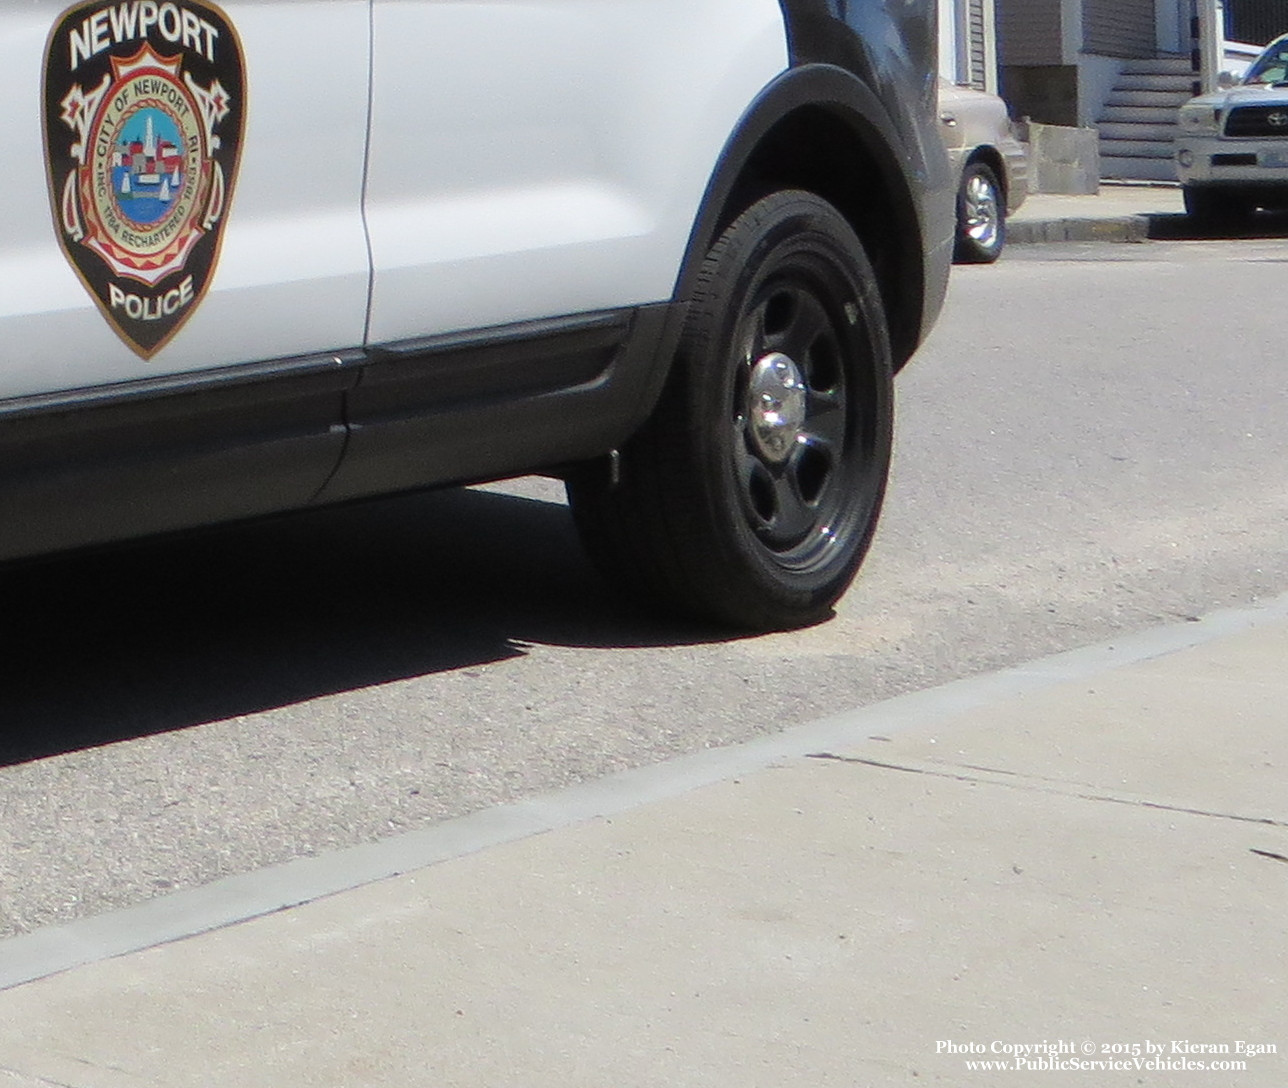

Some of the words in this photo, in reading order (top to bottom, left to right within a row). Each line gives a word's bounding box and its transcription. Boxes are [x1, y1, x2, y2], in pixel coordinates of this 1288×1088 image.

[69, 0, 219, 71] NEWPORT
[97, 113, 115, 158] CITY
[114, 89, 130, 112] OF
[188, 135, 199, 153] RI
[122, 205, 186, 248] RECHARTERED
[108, 274, 195, 321] POLICE
